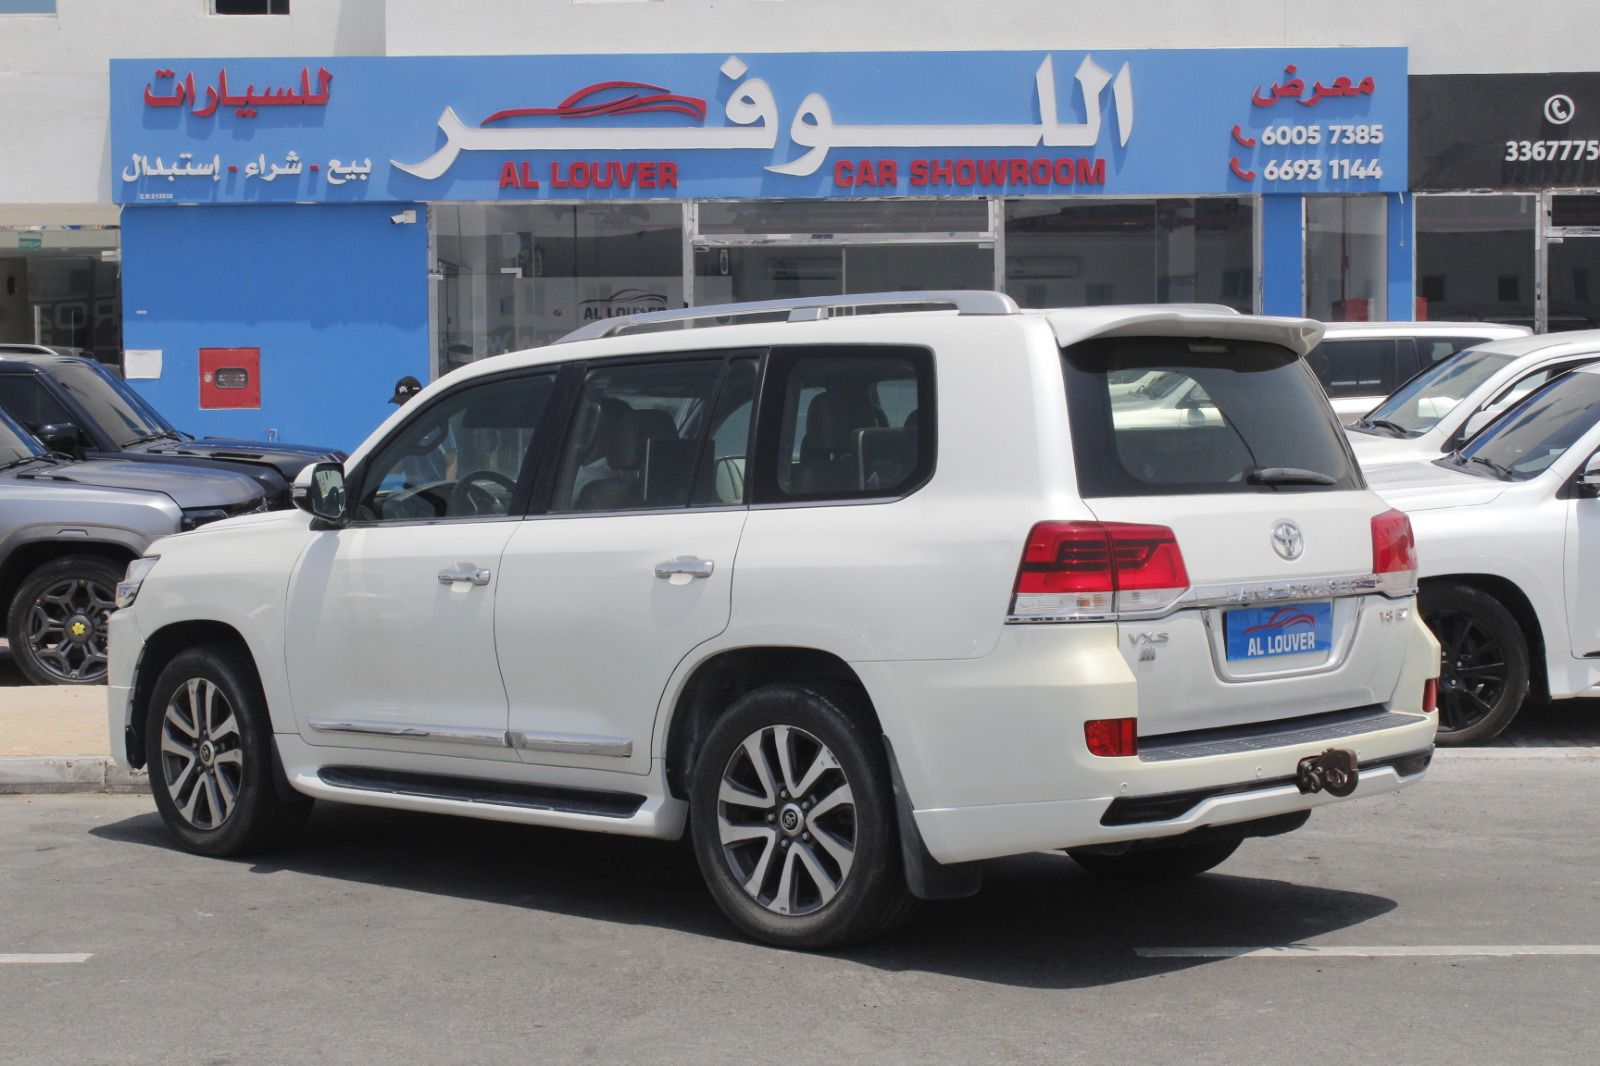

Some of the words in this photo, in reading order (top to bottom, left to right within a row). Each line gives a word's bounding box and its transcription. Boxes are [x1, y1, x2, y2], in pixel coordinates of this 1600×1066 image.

[143, 66, 333, 117] للسيارات
[1252, 64, 1376, 108] معرض
[389, 53, 1134, 181] اللوفر
[1261, 125, 1322, 145] 6005
[1328, 124, 1384, 144] 7385
[244, 150, 302, 181] شراء
[1504, 140, 1600, 162] 3367775
[327, 157, 372, 184] بيع
[500, 162, 541, 188] AL
[551, 161, 679, 189] LOUVER
[834, 159, 898, 187] CAR
[910, 158, 1106, 186] SHOWROOM
[1263, 159, 1322, 180] 6693
[1329, 158, 1383, 179] 1144
[1248, 637, 1264, 656] AL
[1268, 631, 1316, 655] LOUVER
